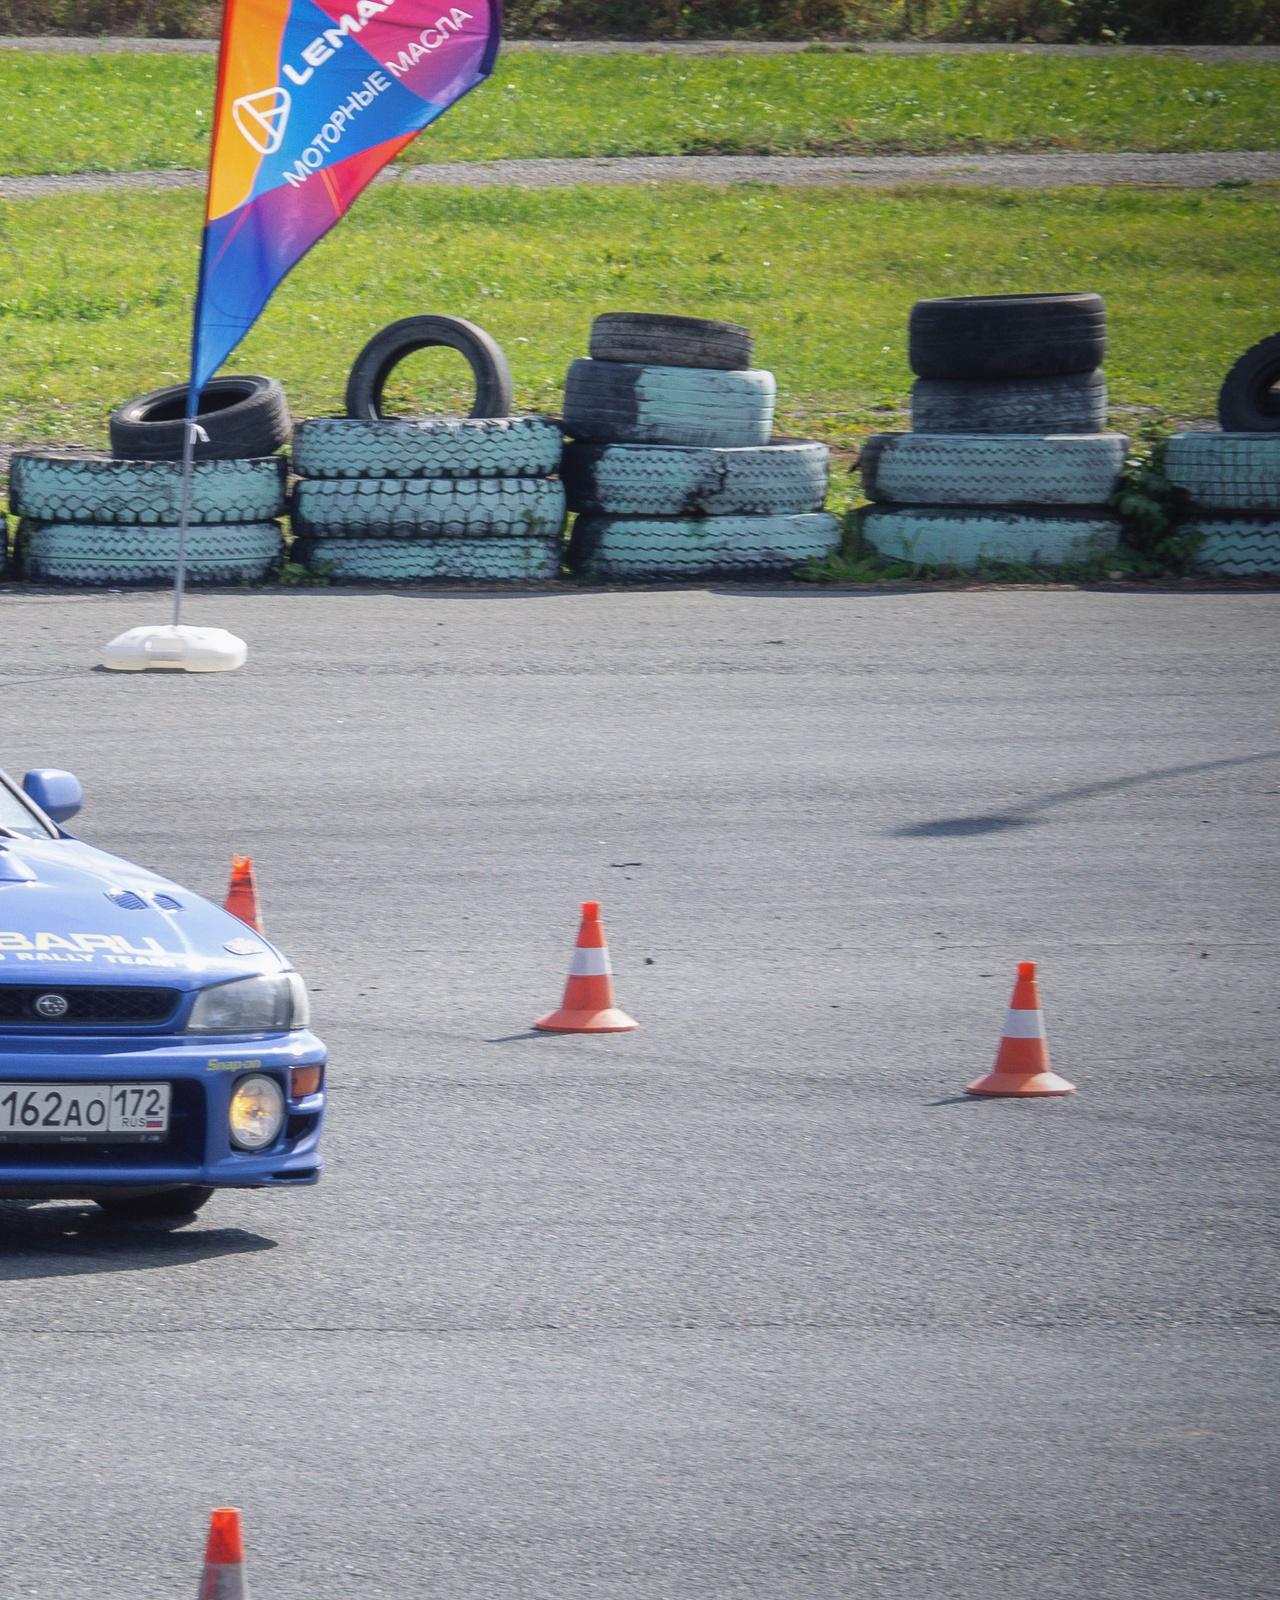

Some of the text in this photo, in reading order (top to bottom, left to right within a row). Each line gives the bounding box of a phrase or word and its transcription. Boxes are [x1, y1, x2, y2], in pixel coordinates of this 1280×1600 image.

[281, 0, 396, 86] LEMA
[282, 7, 474, 188] МОТОРНЫЕ МАСЛА
[16, 952, 94, 963] RALLY
[101, 954, 177, 968] TEAM
[206, 1058, 262, 1072] Snap-on
[114, 1088, 160, 1117] 172
[121, 1117, 147, 1128] RUS
